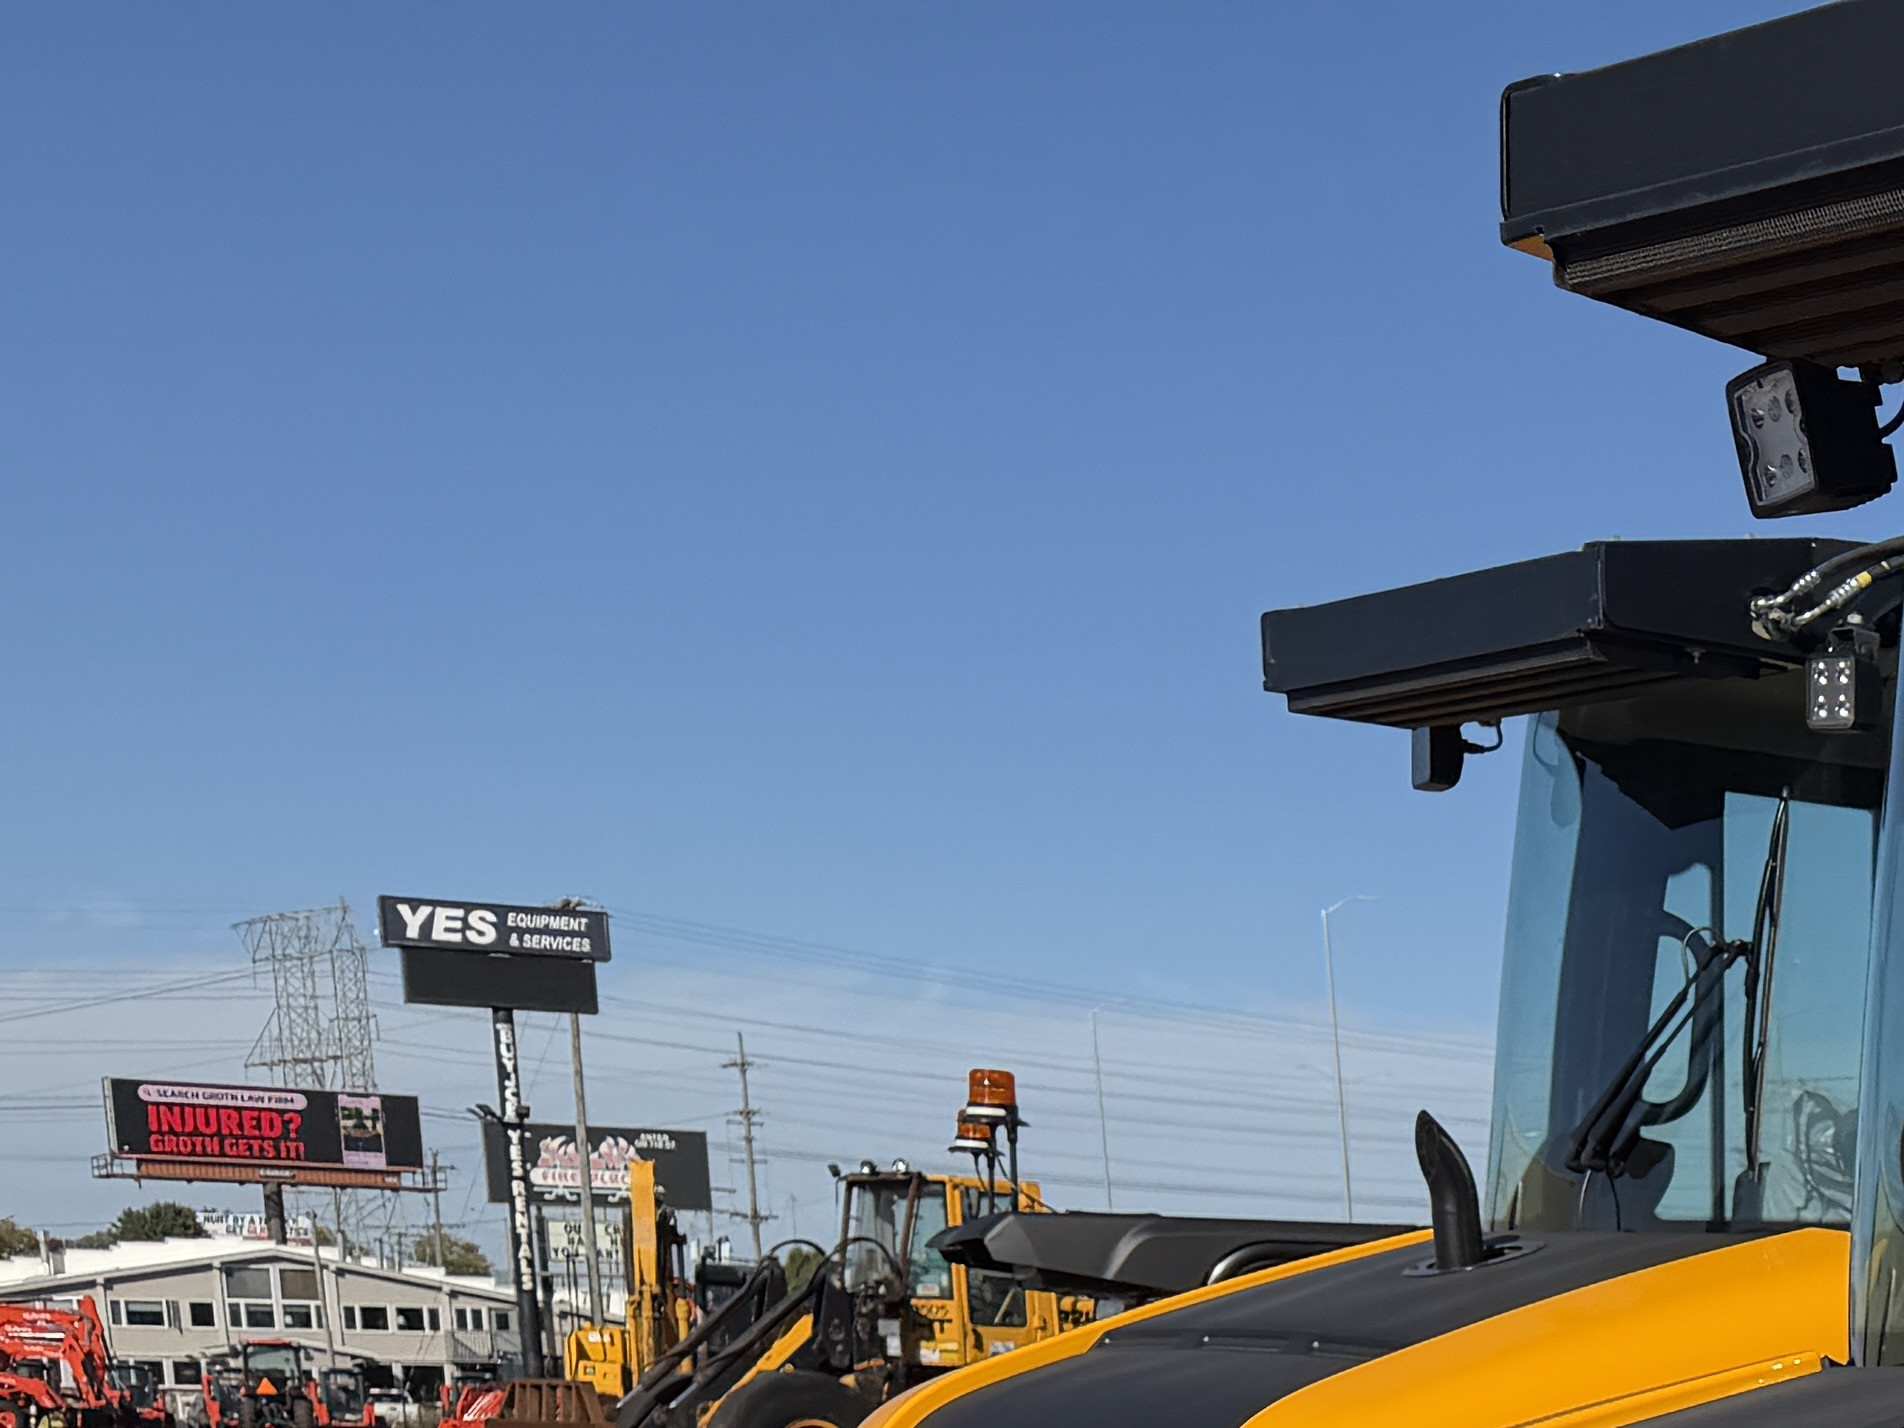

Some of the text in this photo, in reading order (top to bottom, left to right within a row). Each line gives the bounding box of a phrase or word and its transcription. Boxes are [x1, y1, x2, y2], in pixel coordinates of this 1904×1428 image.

[396, 903, 498, 945] YES
[507, 912, 588, 932] EQUIPMENT
[509, 932, 591, 952] & SERVICES
[148, 1103, 303, 1139] INJURED?
[150, 1134, 220, 1155] GROTH
[224, 1139, 277, 1158] GETS
